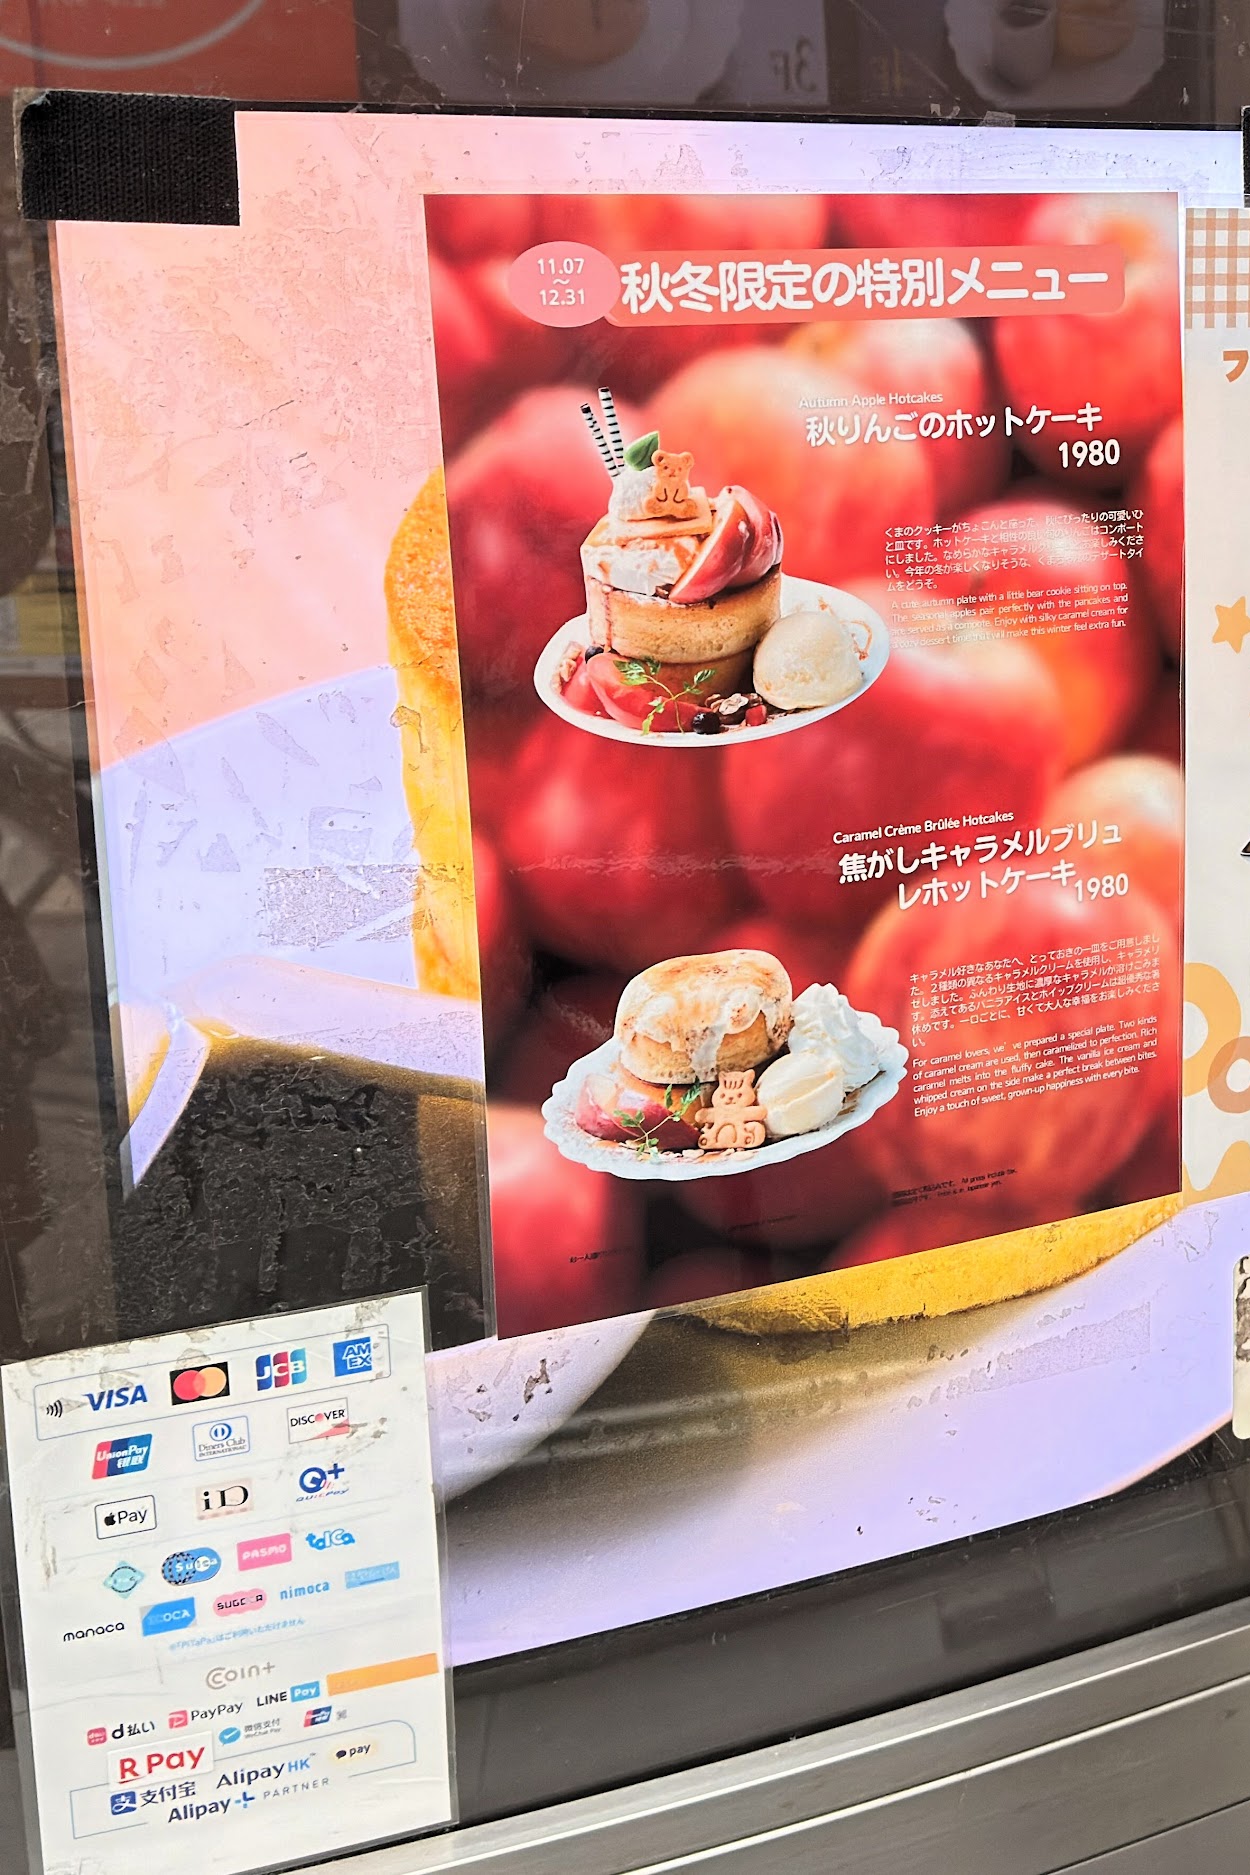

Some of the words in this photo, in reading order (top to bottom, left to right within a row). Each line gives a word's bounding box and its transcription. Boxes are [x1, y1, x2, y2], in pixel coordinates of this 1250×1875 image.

[537, 258, 584, 274] 11.07
[540, 289, 585, 306] 12.31
[620, 257, 1108, 314] 秋冬限定の特別メニュー
[799, 398, 848, 408] Autumn
[851, 394, 885, 408] Apple
[889, 392, 943, 404] Hotcakes
[806, 402, 1102, 447] 秋りんごのホットケーキ
[1058, 439, 1120, 468] 1980
[886, 578, 938, 592] ムをどうぞ。
[956, 595, 976, 606] plate
[978, 593, 996, 602] with
[1007, 591, 1024, 599] little
[1027, 590, 1043, 598] bear
[1046, 586, 1071, 596] cookie
[1074, 584, 1098, 594] sitting
[1113, 583, 1127, 591] top.
[951, 608, 976, 618] apples
[980, 607, 995, 615] pair
[998, 602, 1034, 614] perfectly
[1037, 601, 1054, 609] with
[1075, 596, 1110, 608] pancakes
[1114, 594, 1128, 602] and
[995, 618, 1018, 628] Enjoy
[1020, 615, 1036, 623] with
[1039, 613, 1057, 622] silky
[1058, 610, 1089, 620] caramel
[1091, 608, 1115, 617] cream
[1117, 606, 1128, 614] for
[1007, 630, 1028, 638] make
[1031, 627, 1045, 635] this
[1047, 625, 1072, 633] winter
[1074, 622, 1087, 631] feel
[1089, 621, 1109, 630] extra
[1111, 619, 1126, 627] fun.
[833, 827, 882, 845] Caramel
[884, 823, 921, 837] Crème
[924, 817, 960, 833] Brûlée
[962, 811, 1014, 826] Hotcakes
[839, 820, 1122, 883] 焦がしキャラメルブリュ
[899, 859, 1077, 910] レホットケーキ
[1074, 874, 1128, 902] 1980
[912, 1038, 925, 1047] い。
[913, 1059, 927, 1067] For
[930, 1052, 961, 1064] caramel
[965, 1049, 990, 1058] lovers,
[1024, 1034, 1057, 1048] prepared
[1068, 1027, 1093, 1040] special
[1096, 1024, 1115, 1035] plate.
[1119, 1020, 1134, 1029] Two
[1138, 1016, 1157, 1025] kinds
[913, 1071, 922, 1080] of
[925, 1065, 956, 1078] caramel
[959, 1060, 983, 1071] cream
[986, 1058, 998, 1066] are
[1001, 1054, 1020, 1063] used,
[1024, 1050, 1040, 1060] then
[1043, 1040, 1087, 1055] caramelized
[1100, 1032, 1138, 1046] perfection.
[1141, 1028, 1157, 1037] Rich
[914, 1080, 945, 1092] caramel
[950, 1075, 971, 1085] melts
[975, 1072, 990, 1080] into
[1011, 1063, 1032, 1074] fluffy
[1036, 1060, 1055, 1069] cake.
[1059, 1056, 1073, 1064] The
[1077, 1050, 1100, 1061] vanilla
[1117, 1043, 1140, 1053] cream
[1143, 1038, 1157, 1048] and
[914, 1092, 947, 1104] whipped
[950, 1087, 974, 1097] cream
[977, 1085, 987, 1093] on
[990, 1082, 1002, 1090] the
[1005, 1078, 1020, 1087] side
[1023, 1074, 1043, 1083] make
[1053, 1066, 1080, 1079] perfect
[1082, 1062, 1102, 1071] break
[1105, 1055, 1135, 1066] between
[1138, 1051, 1157, 1060] bites.
[915, 1106, 938, 1117] Enjoy
[947, 1099, 969, 1110] touch
[971, 1097, 980, 1105] of
[982, 1094, 1006, 1104] sweet,
[1008, 1086, 1045, 1100] grown-up
[1046, 1077, 1083, 1091] happiness
[1085, 1073, 1101, 1083] with
[1103, 1070, 1123, 1079] every
[1124, 1066, 1139, 1075] bite.
[83, 1384, 148, 1411] VISA
[256, 1355, 307, 1385] JCB
[96, 1445, 148, 1461] UnionPay
[199, 1439, 223, 1452] Diners
[226, 1434, 246, 1446] Club
[118, 1509, 147, 1524] Pay
[202, 1485, 249, 1511] iD
[175, 1556, 217, 1573] Suica
[241, 1544, 287, 1560] PASMO
[63, 1622, 125, 1642] manaca
[280, 1580, 330, 1600] nimoca
[111, 1721, 155, 1740] d払い
[191, 1702, 243, 1720] PayPay
[257, 1691, 288, 1707] LINE
[293, 1684, 317, 1698] Pay
[119, 1758, 139, 1780] R
[147, 1747, 205, 1774] Pay
[349, 1744, 371, 1757] pay
[140, 1781, 196, 1807] 支付宝
[263, 1777, 330, 1799] PARTNER
